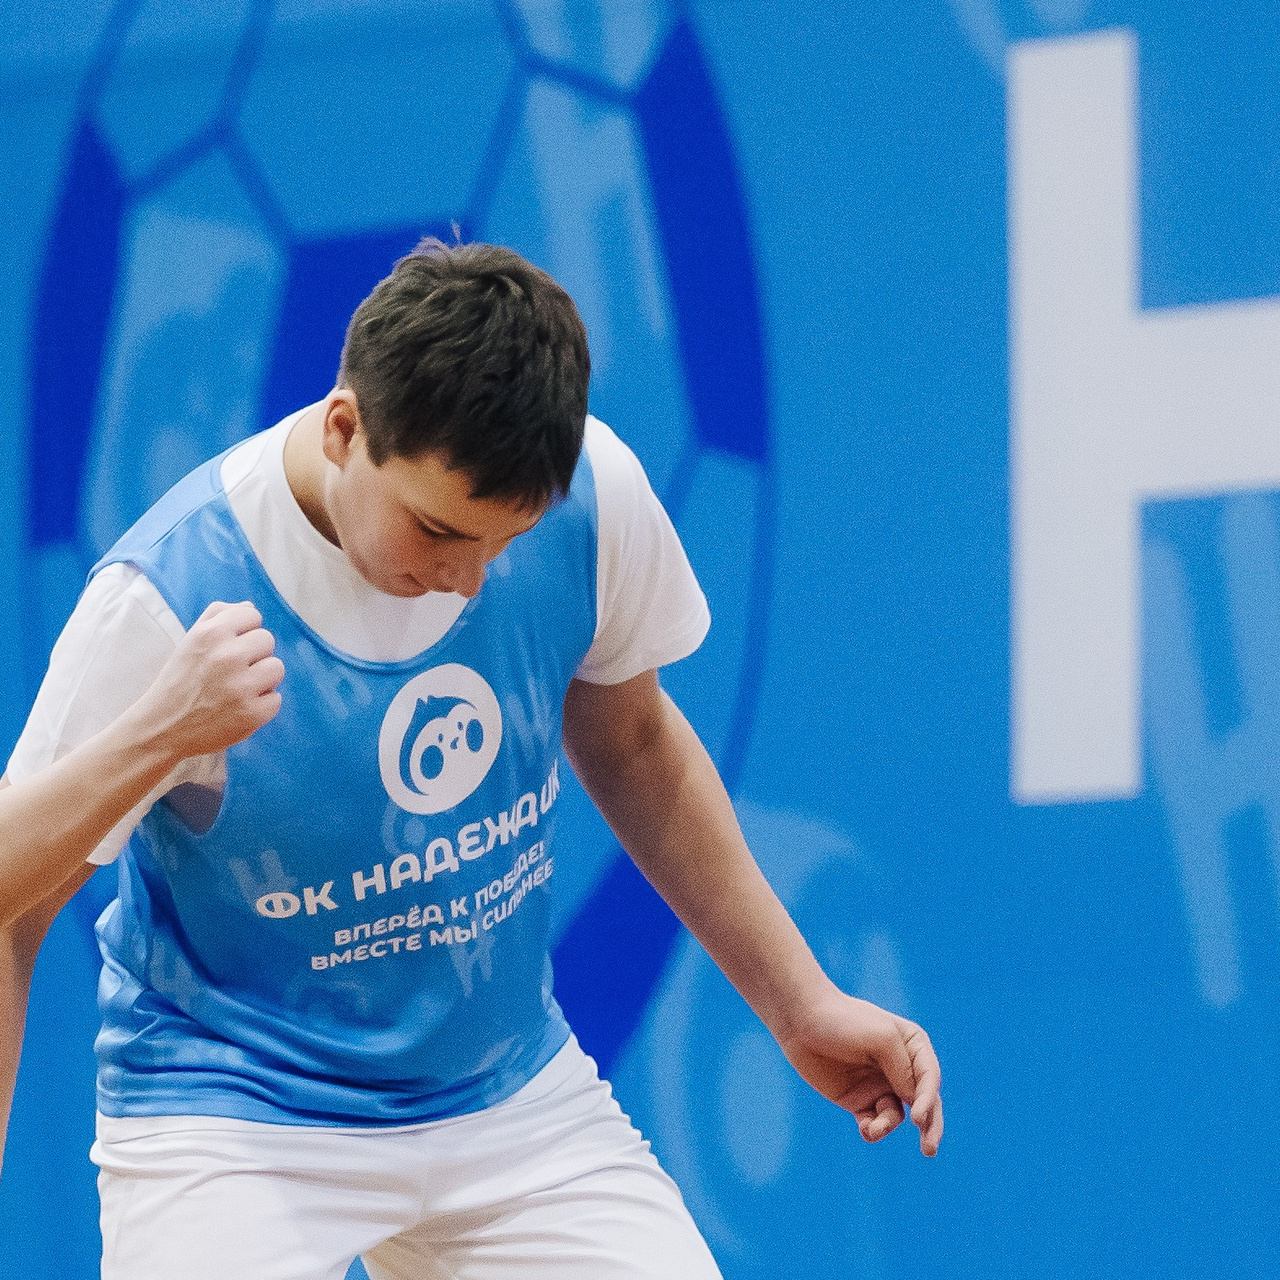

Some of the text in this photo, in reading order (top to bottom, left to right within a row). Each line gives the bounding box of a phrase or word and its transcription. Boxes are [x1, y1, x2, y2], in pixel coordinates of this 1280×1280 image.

[256, 879, 339, 919] ФК
[334, 903, 445, 947] ВПЕРЁД
[449, 895, 469, 919] К
[310, 932, 422, 971] ВМЕСТЕ
[429, 920, 478, 947] МЫ
